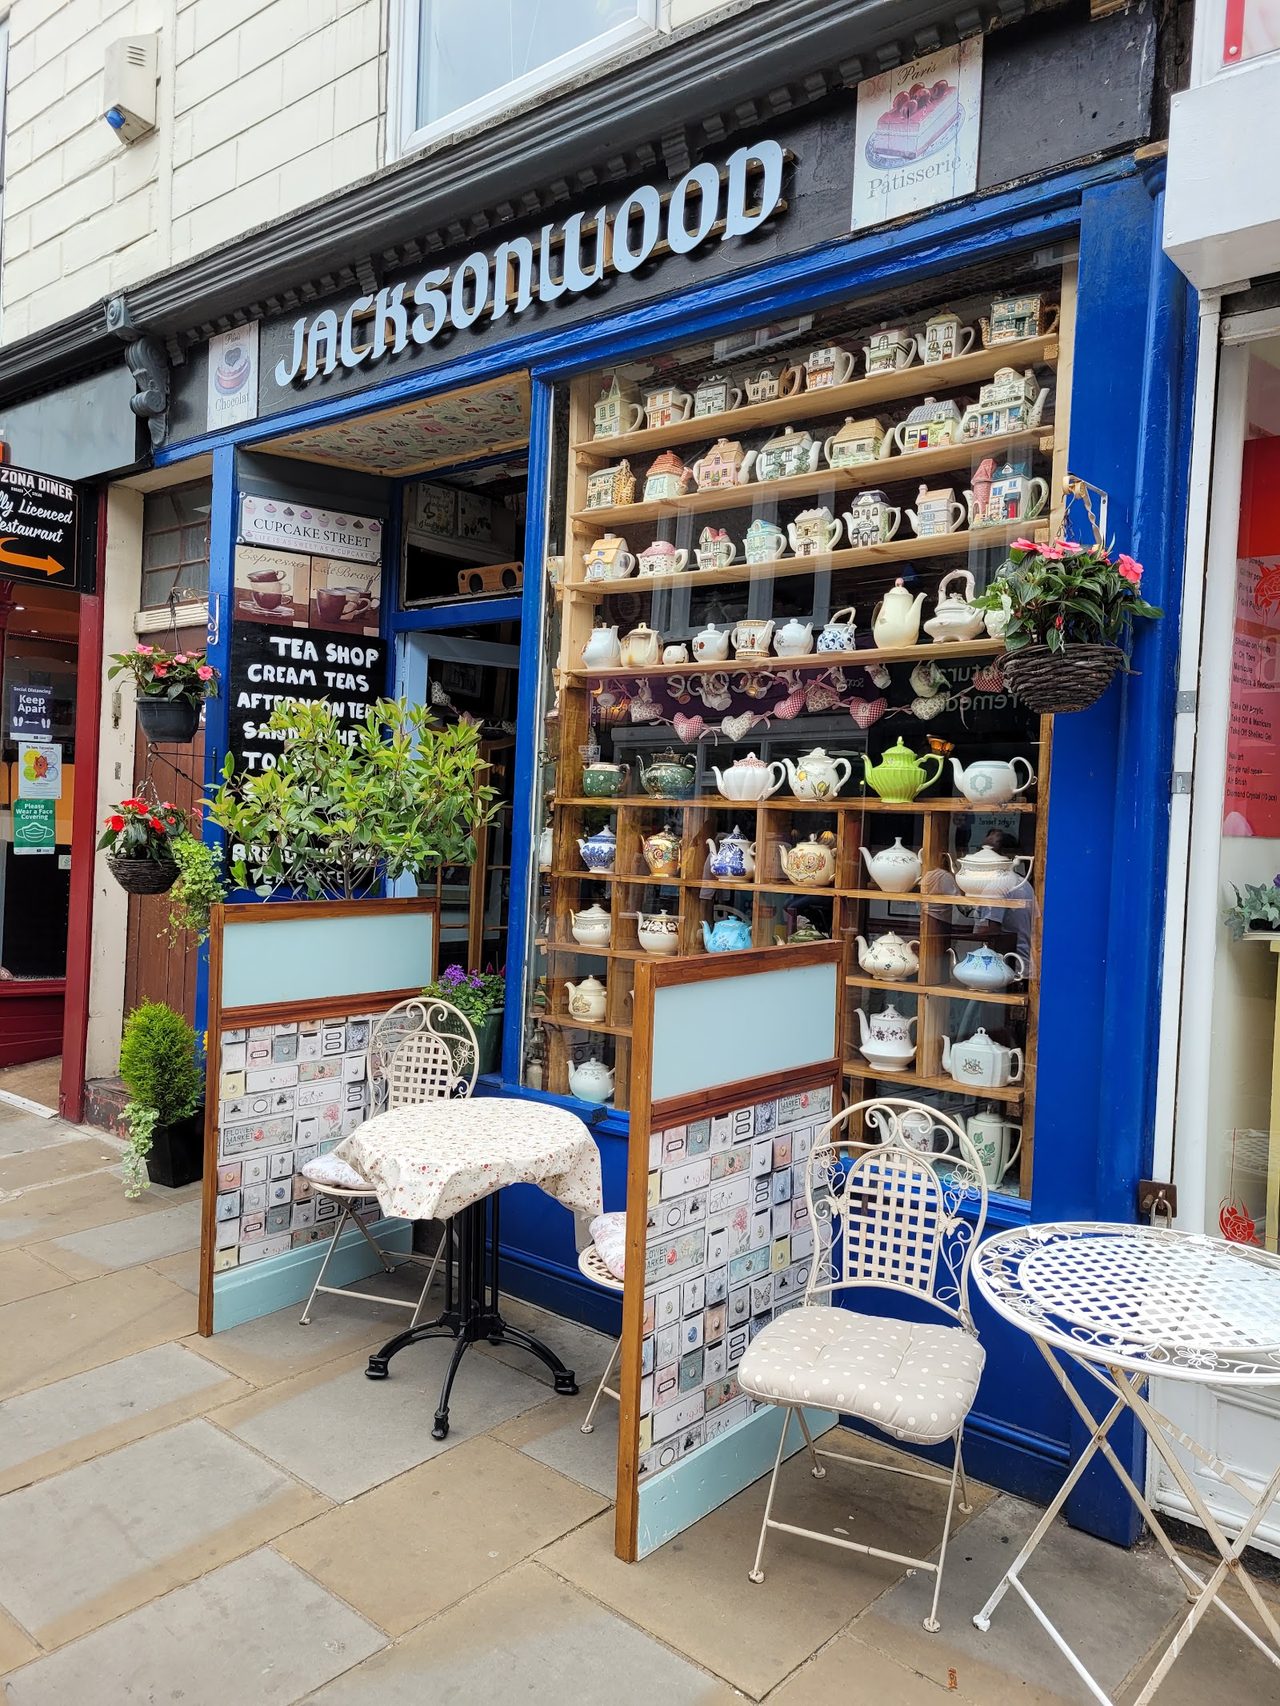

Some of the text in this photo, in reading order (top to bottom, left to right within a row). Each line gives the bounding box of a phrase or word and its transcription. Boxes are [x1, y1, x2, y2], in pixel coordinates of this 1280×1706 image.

[897, 61, 937, 86] Paris
[867, 154, 961, 199] Pâtisserie
[215, 393, 249, 412] Chocolat
[38, 478, 73, 501] DINER
[18, 498, 73, 525] Licenced
[0, 516, 64, 543] estaurant
[253, 518, 372, 548] CUPCAKE STREET
[239, 549, 307, 568] Espresso
[269, 636, 380, 669] TEA SHOP
[247, 663, 370, 693] CREAM TEAS
[17, 703, 46, 714] Apart
[19, 694, 45, 706] Keep
[226, 1126, 255, 1138] FLOWER
[226, 1132, 254, 1145] MARKET
